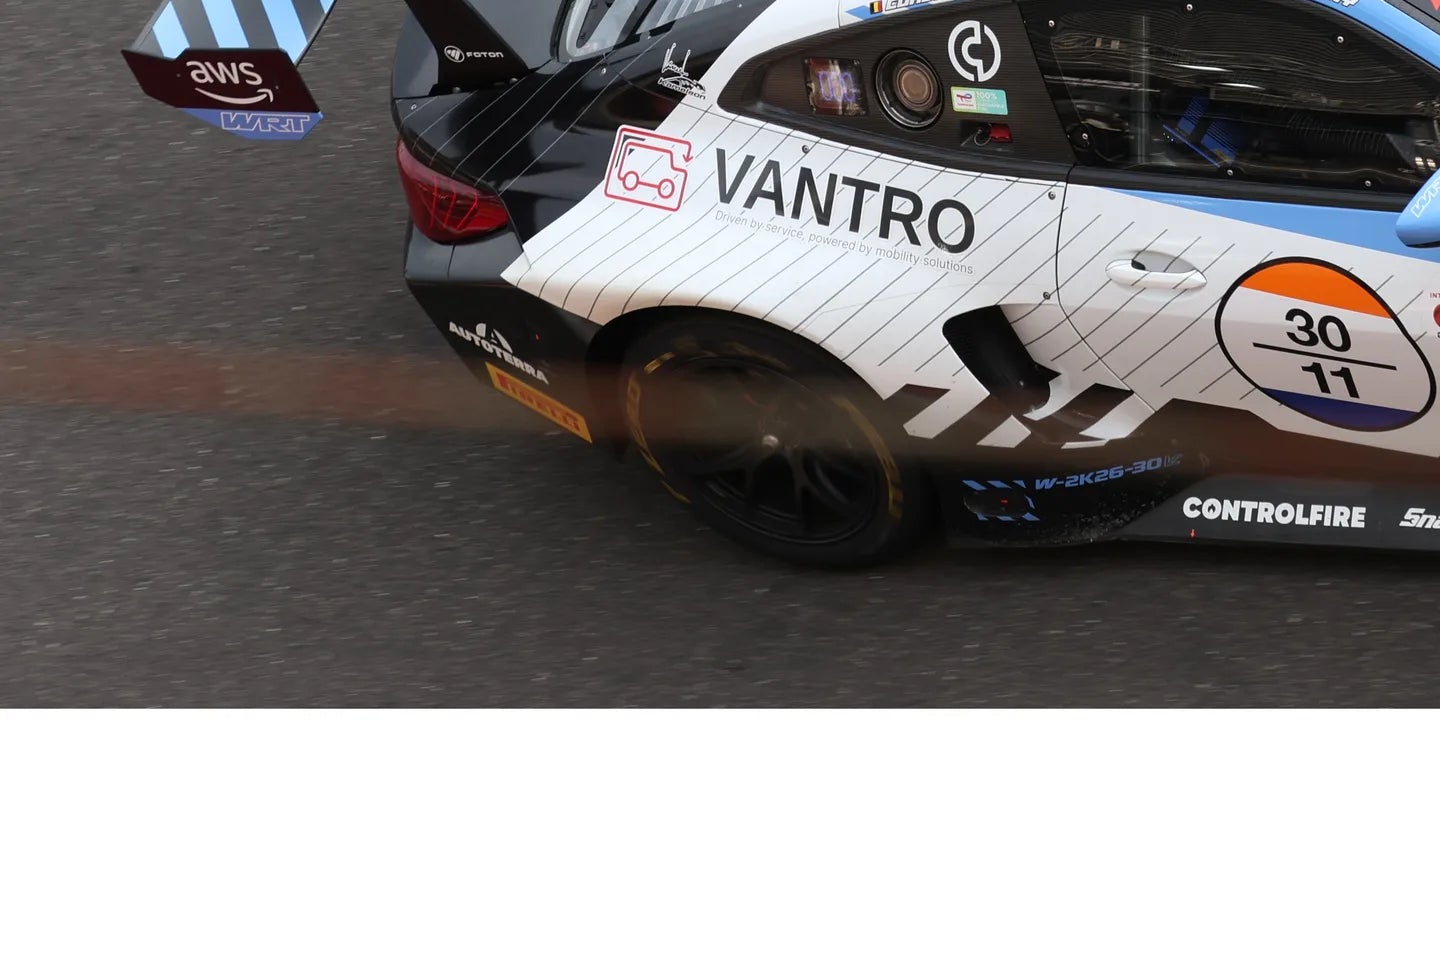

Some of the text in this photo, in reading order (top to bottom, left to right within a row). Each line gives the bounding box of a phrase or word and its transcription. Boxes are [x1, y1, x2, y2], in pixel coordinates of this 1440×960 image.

[186, 60, 263, 86] aws
[220, 111, 311, 133] WRT
[715, 147, 976, 254] VANTRO
[715, 209, 974, 275] Driven by service, powered by mobility solutions
[1285, 308, 1352, 353] 30
[449, 321, 550, 385] AUTOTERRA
[1301, 362, 1360, 399] 11
[1183, 497, 1366, 529] CONTROLFIRE
